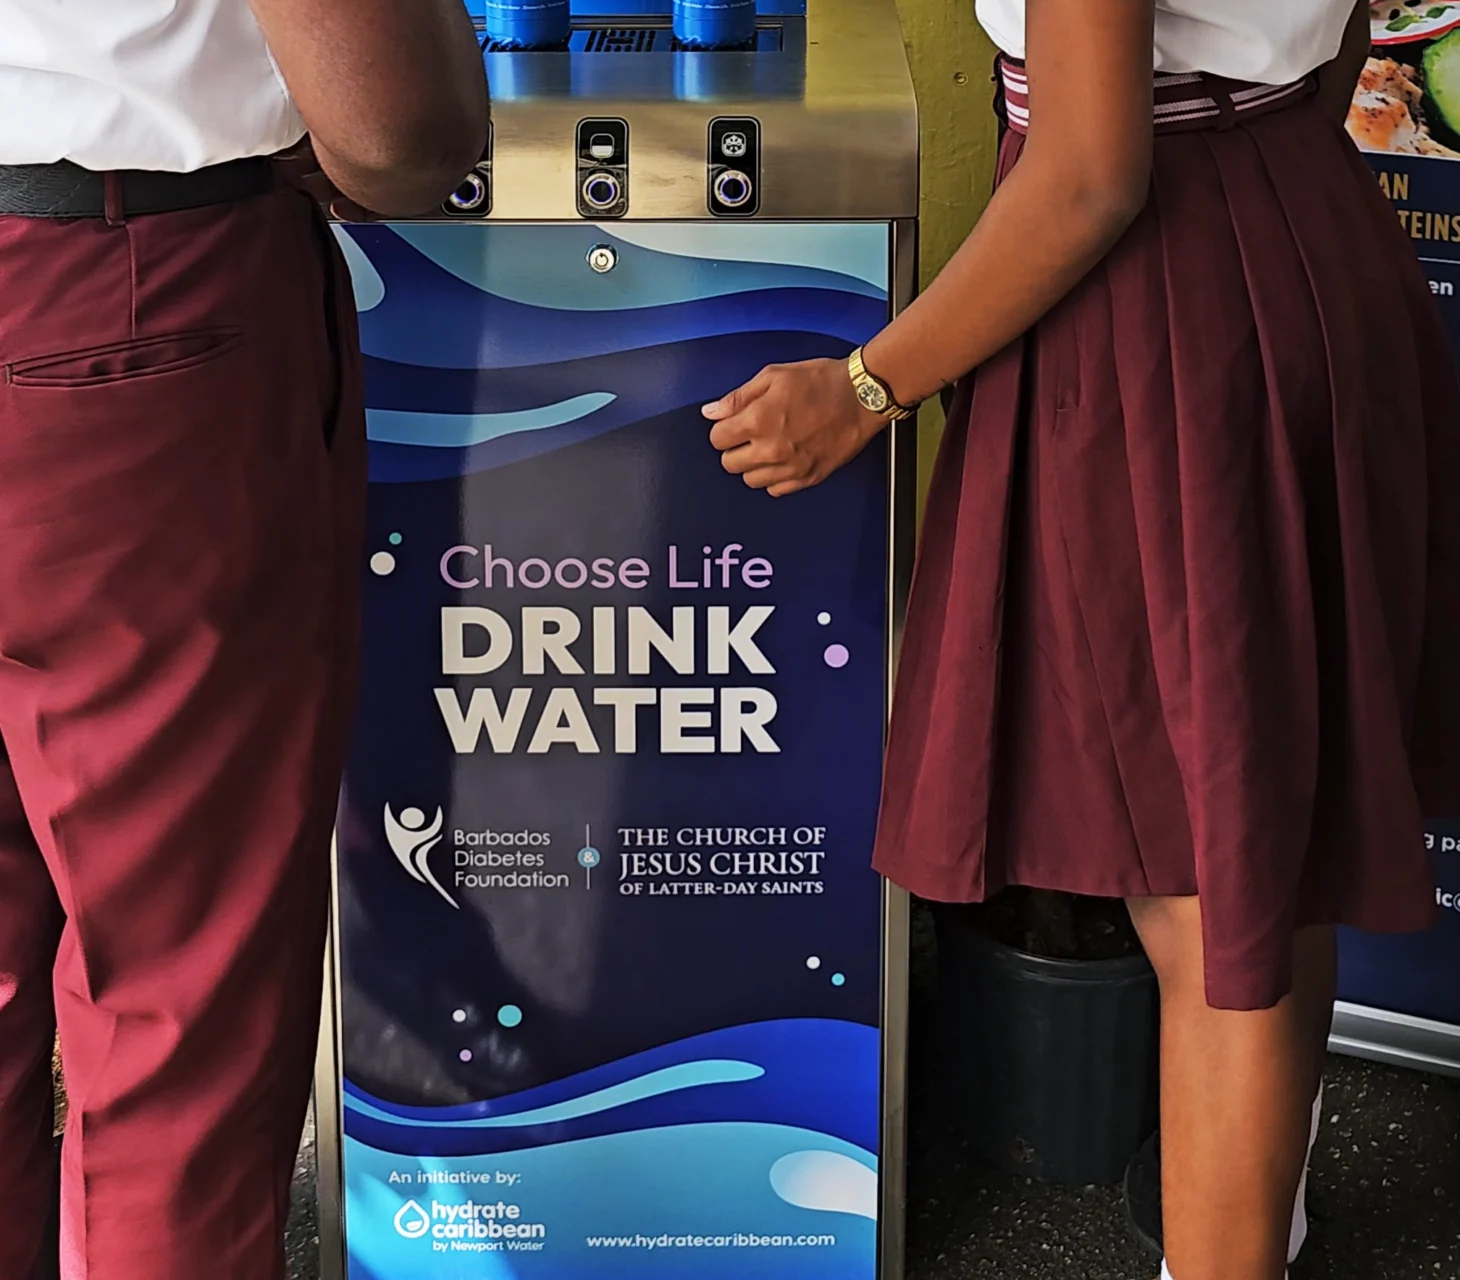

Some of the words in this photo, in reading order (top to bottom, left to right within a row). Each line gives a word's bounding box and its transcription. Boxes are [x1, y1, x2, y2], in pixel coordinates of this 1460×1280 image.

[439, 544, 651, 589] Choose
[668, 543, 774, 589] Life
[441, 605, 777, 675] DRINK
[433, 687, 782, 754] WATER
[453, 829, 551, 846] Barbados
[618, 827, 669, 846] THE
[676, 827, 787, 846] CHURCH
[793, 826, 827, 845] OF
[454, 851, 545, 867] Diabetes
[582, 852, 595, 863] &
[619, 851, 701, 880] JESUS
[709, 851, 825, 876] CHRIST
[455, 871, 569, 888] Foundation
[619, 881, 643, 895] OF
[648, 881, 757, 895] LATTER-DAY
[762, 880, 824, 894] SAINTS
[388, 1170, 412, 1184] An
[417, 1169, 491, 1184] initiative
[495, 1170, 521, 1187] by:
[431, 1199, 520, 1223] hydrate
[431, 1219, 545, 1238] caribbean
[432, 1240, 449, 1253] by
[451, 1240, 504, 1253] Newport
[506, 1240, 545, 1252] Water
[586, 1232, 836, 1249] www.hydratecaribbean.com
